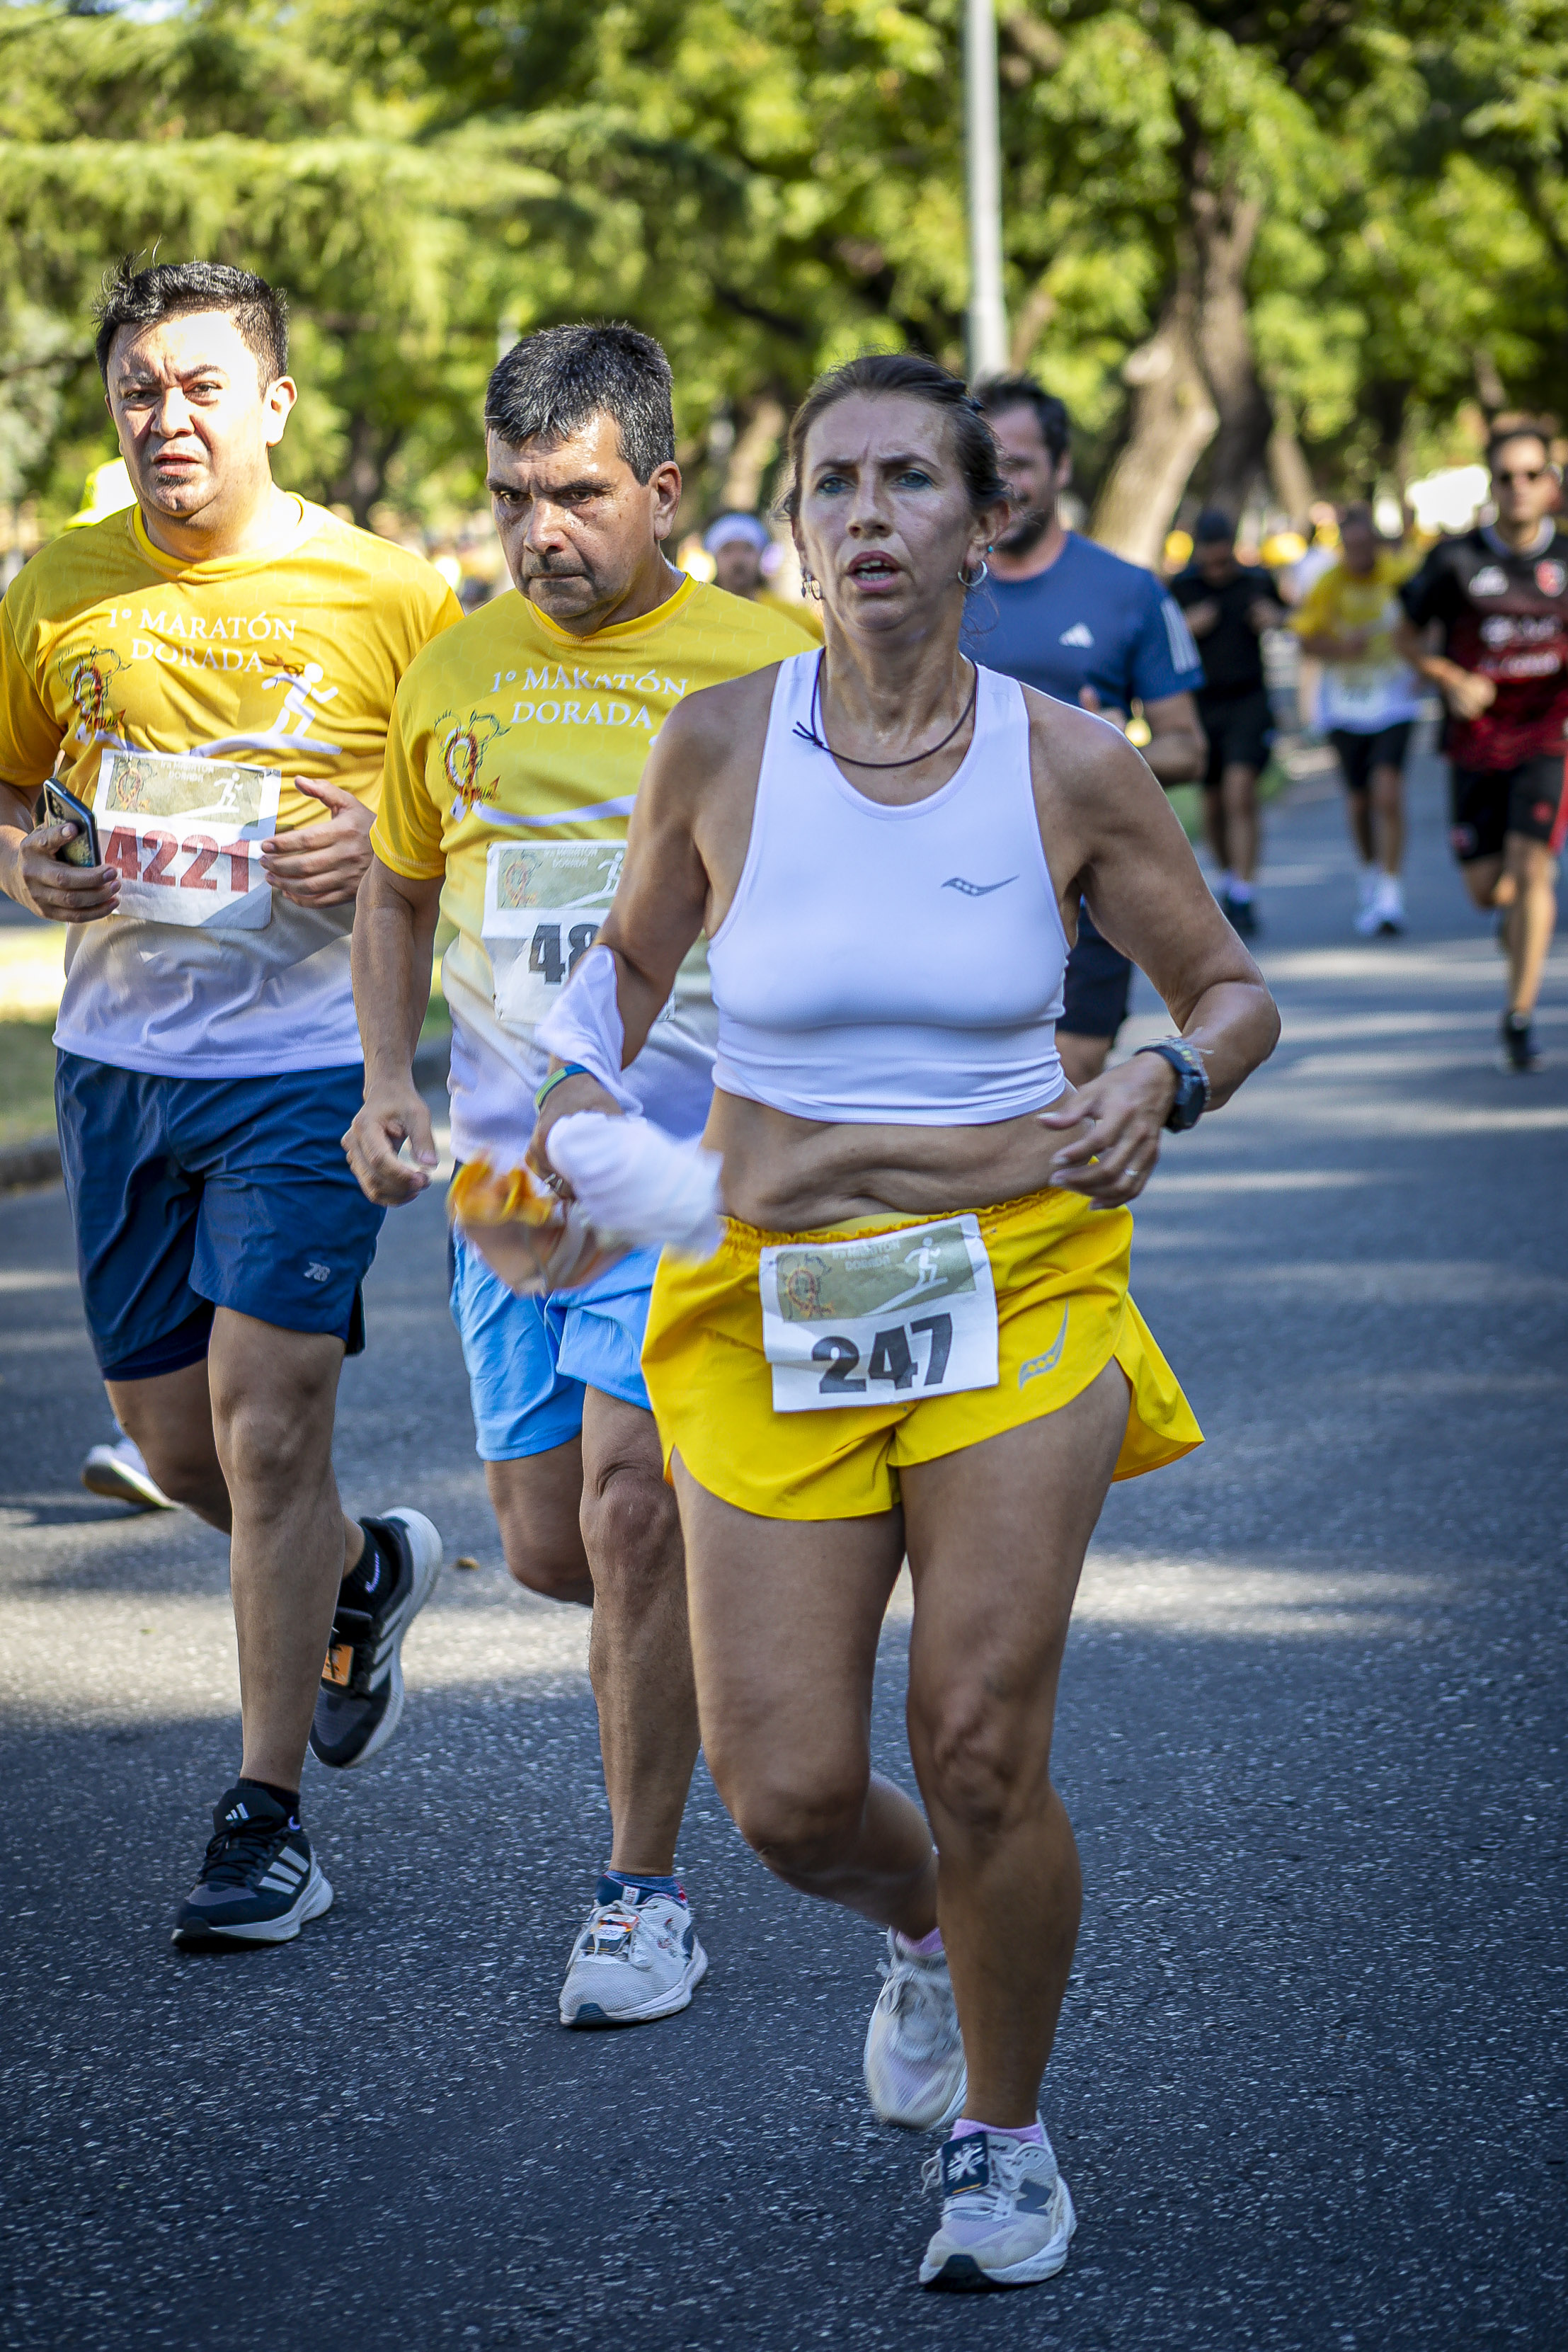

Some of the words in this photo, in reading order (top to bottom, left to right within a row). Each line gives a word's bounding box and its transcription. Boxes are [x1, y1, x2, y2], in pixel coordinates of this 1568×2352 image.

[139, 609, 297, 641] MARATÓN
[130, 639, 265, 673] DORADA
[510, 700, 653, 730] DORADA
[105, 826, 250, 893] 4221
[811, 1312, 953, 1394] 247
